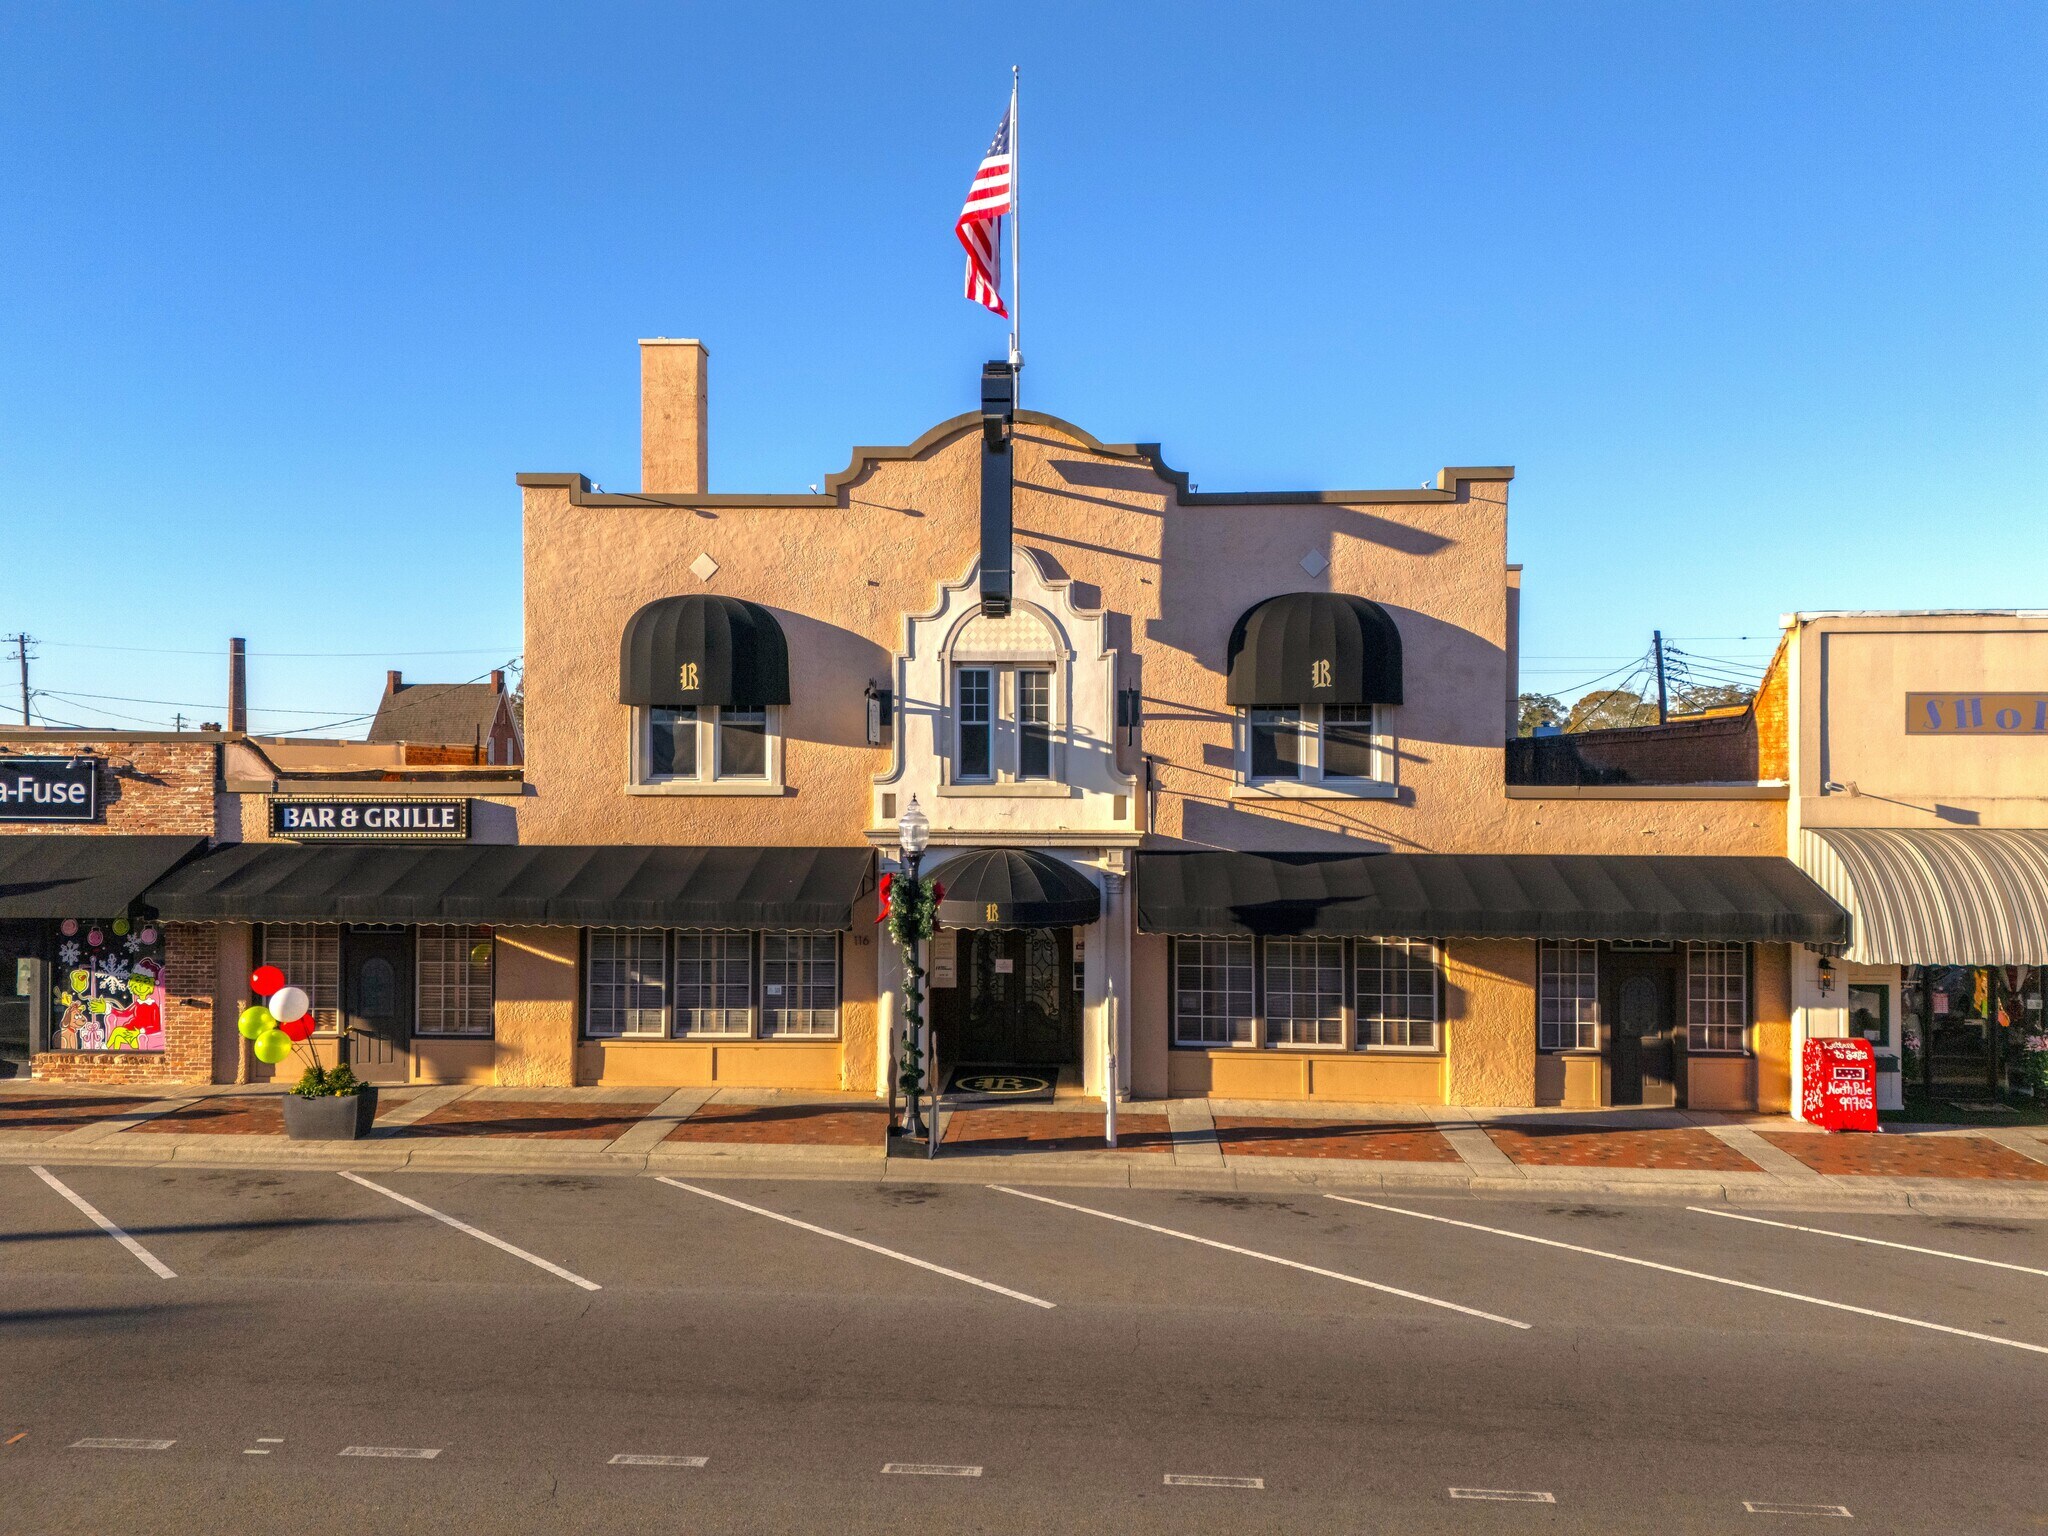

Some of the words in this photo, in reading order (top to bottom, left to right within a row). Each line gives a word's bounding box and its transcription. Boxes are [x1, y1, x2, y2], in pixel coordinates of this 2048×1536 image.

[283, 807, 336, 828] BAR
[340, 807, 359, 828] &
[364, 807, 455, 828] GRILLE
[854, 935, 870, 946] 116
[1834, 1049, 1845, 1060] to
[1826, 1081, 1853, 1096] North
[1852, 1081, 1873, 1096] Pole
[1839, 1096, 1873, 1112] 99705
